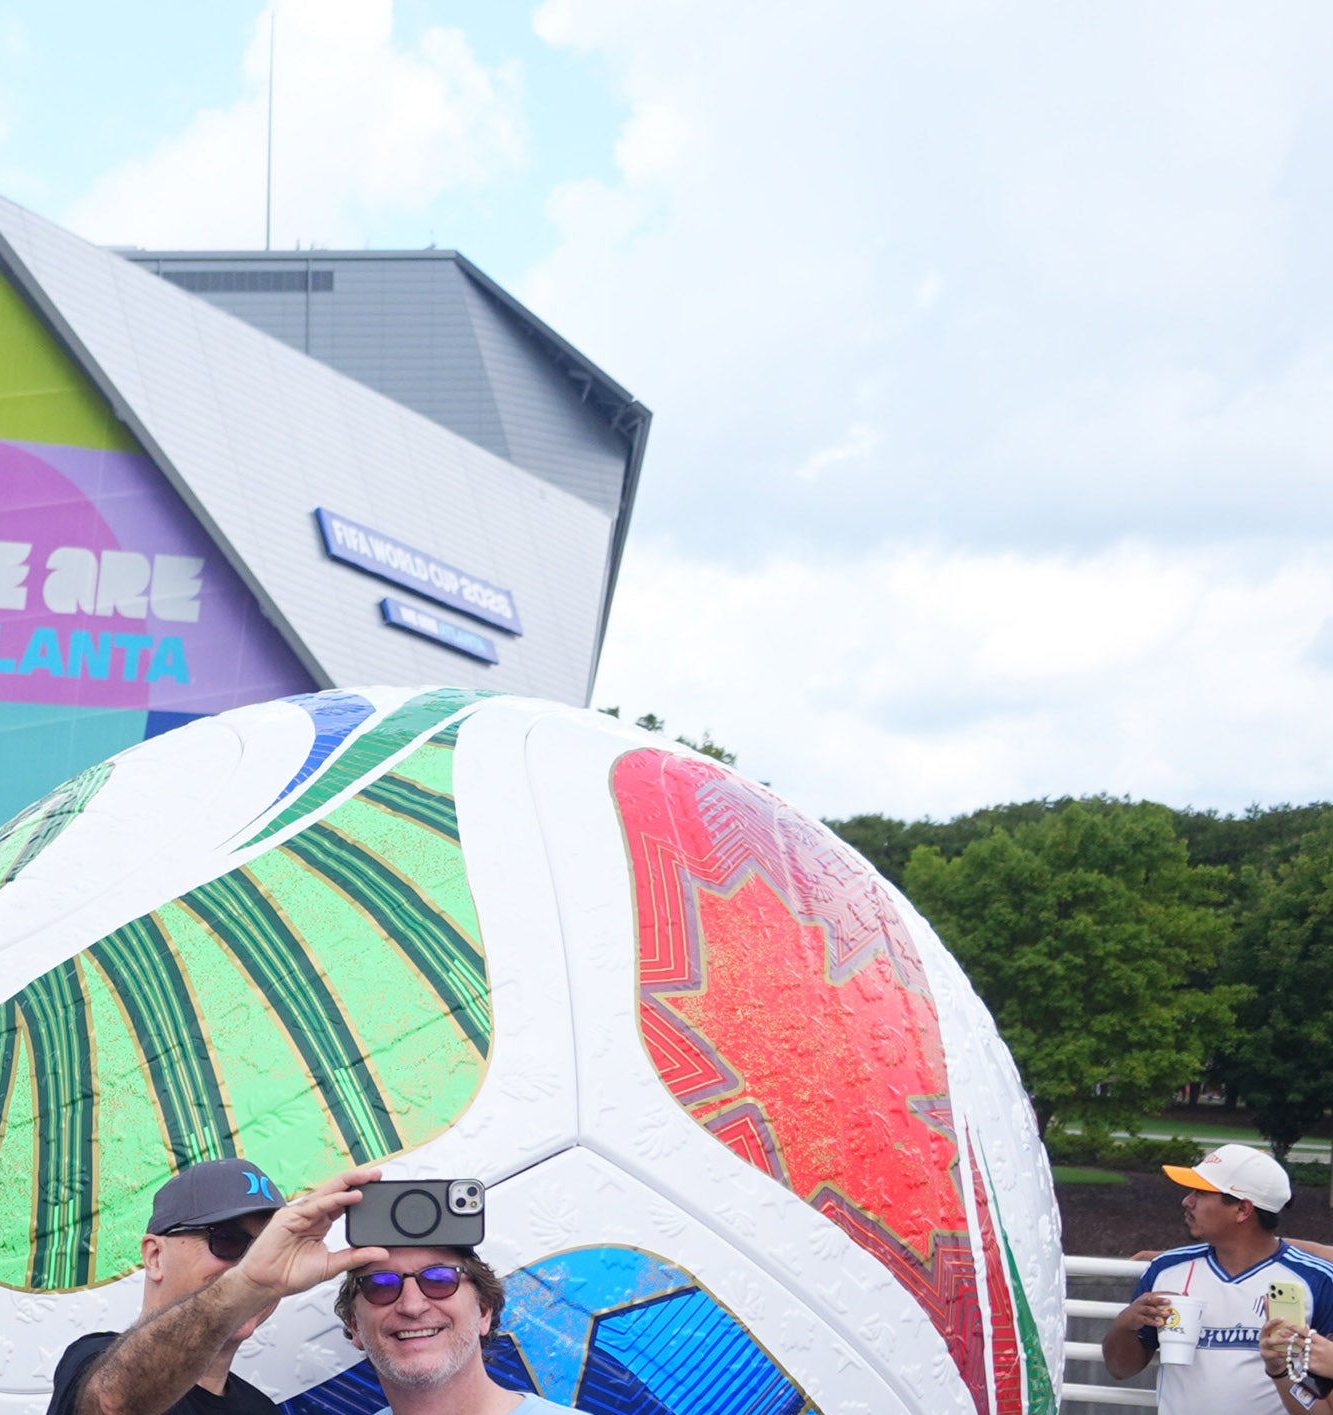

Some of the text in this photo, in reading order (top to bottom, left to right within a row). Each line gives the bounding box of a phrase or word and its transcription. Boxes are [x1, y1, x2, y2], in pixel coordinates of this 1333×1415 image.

[332, 519, 373, 558] FIFA
[368, 539, 428, 582] WORLD
[429, 562, 461, 594] CUP
